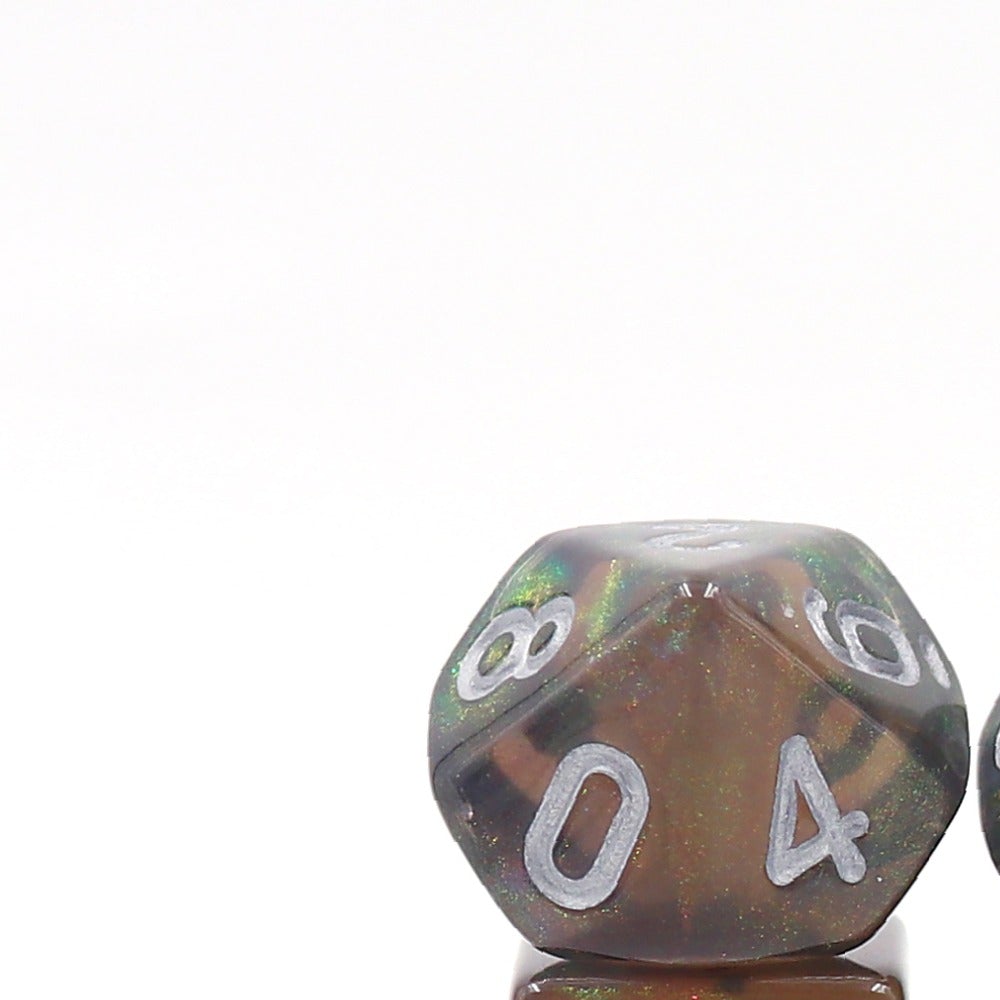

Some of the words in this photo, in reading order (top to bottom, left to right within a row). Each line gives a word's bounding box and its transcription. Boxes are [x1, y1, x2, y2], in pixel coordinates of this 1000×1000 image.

[456, 596, 575, 700] 8
[524, 742, 650, 911] 0
[765, 735, 869, 887] 4
